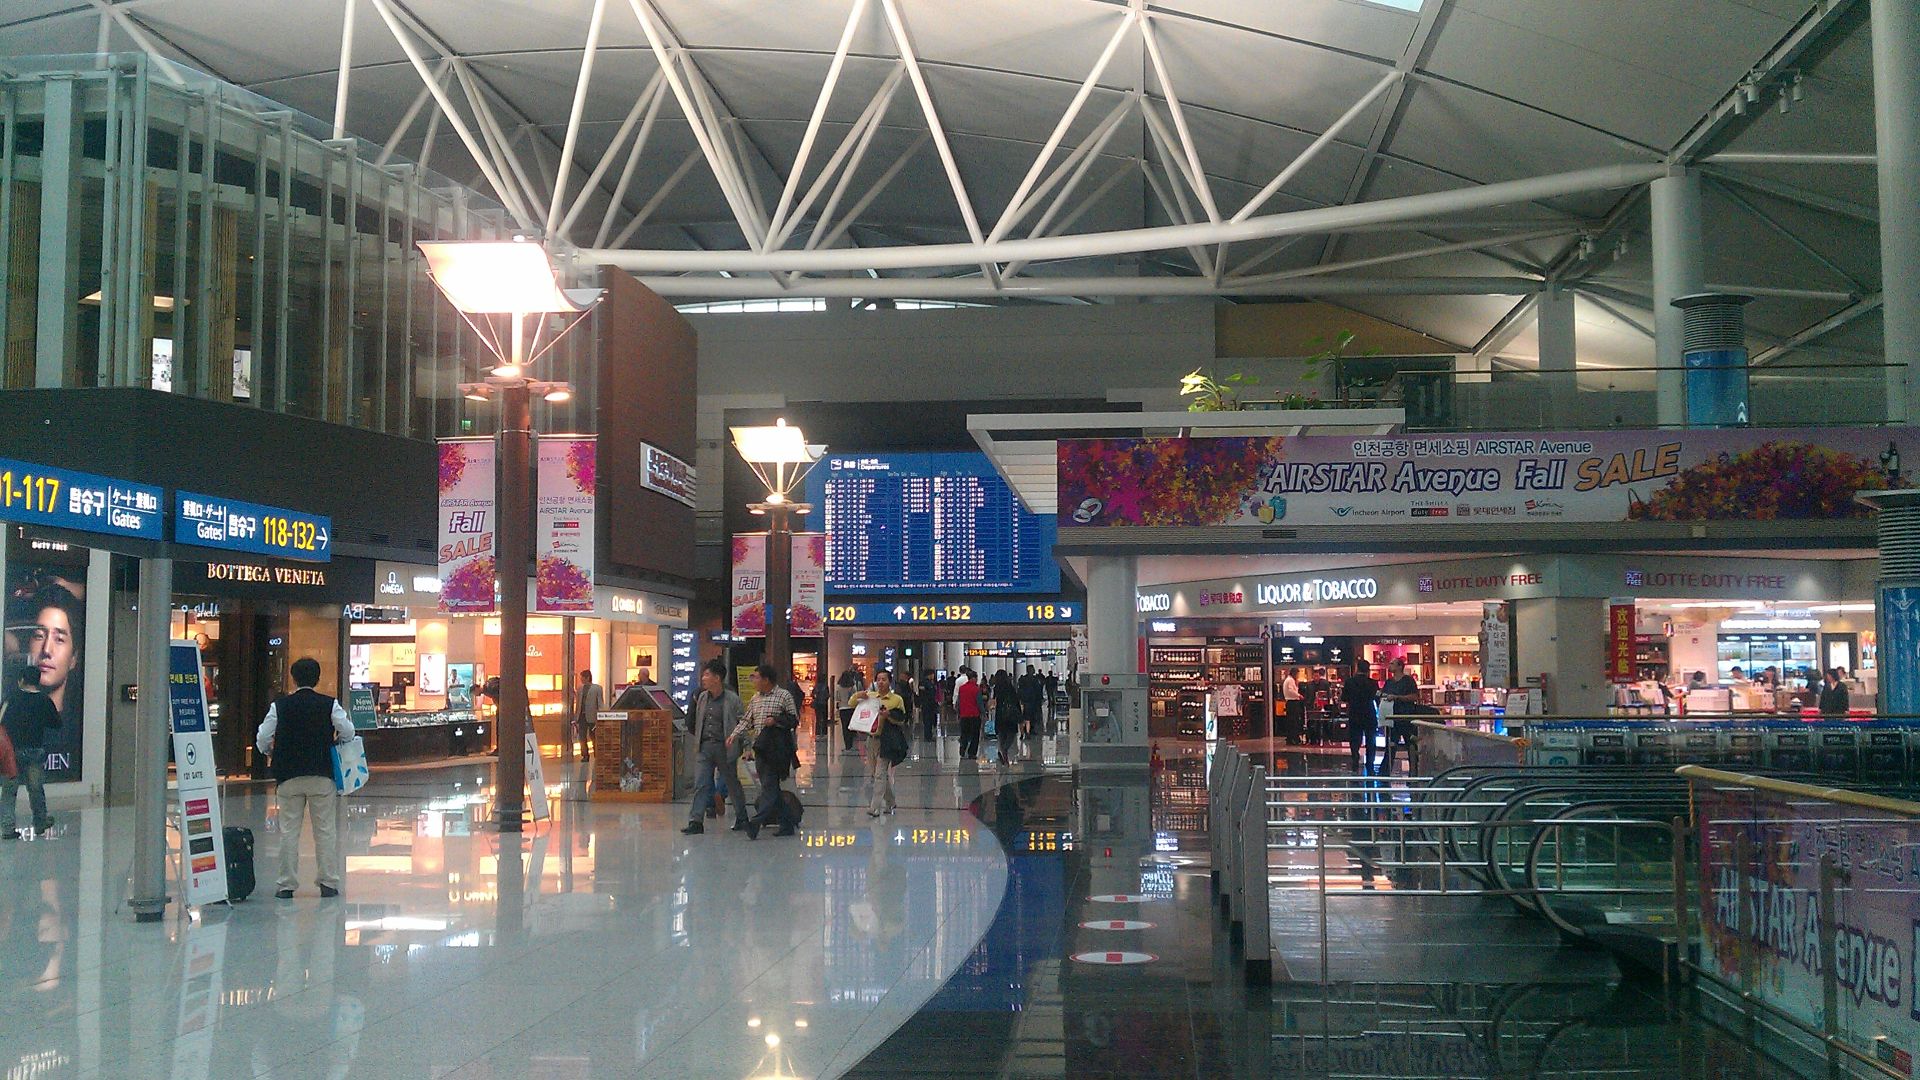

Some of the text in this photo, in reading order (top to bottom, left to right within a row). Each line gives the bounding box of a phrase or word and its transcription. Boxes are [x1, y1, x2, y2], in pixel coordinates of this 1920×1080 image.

[1353, 440, 1592, 457] 인천공항 면세쇼핑 AIRSTAR Avenue
[1263, 442, 1682, 497] AIRSTAR Avenue Fall SALE
[112, 509, 141, 530] Gates
[449, 511, 486, 533] Fall
[1352, 508, 1405, 518] Incheon Airport
[197, 522, 222, 541] Gates
[263, 516, 315, 550] 118-132
[438, 532, 493, 564] SALE
[208, 562, 325, 586] BOTTEGA VENETA
[1437, 573, 1543, 589] LOTTE DUTY FREE
[1646, 572, 1786, 589] LOTTE DUTY FREE
[380, 583, 405, 595] OMEGA
[738, 577, 759, 590] Fall
[1257, 577, 1377, 605] LIQUOR & TOBACCO
[911, 605, 971, 620] 121-132
[1027, 605, 1055, 619] 118
